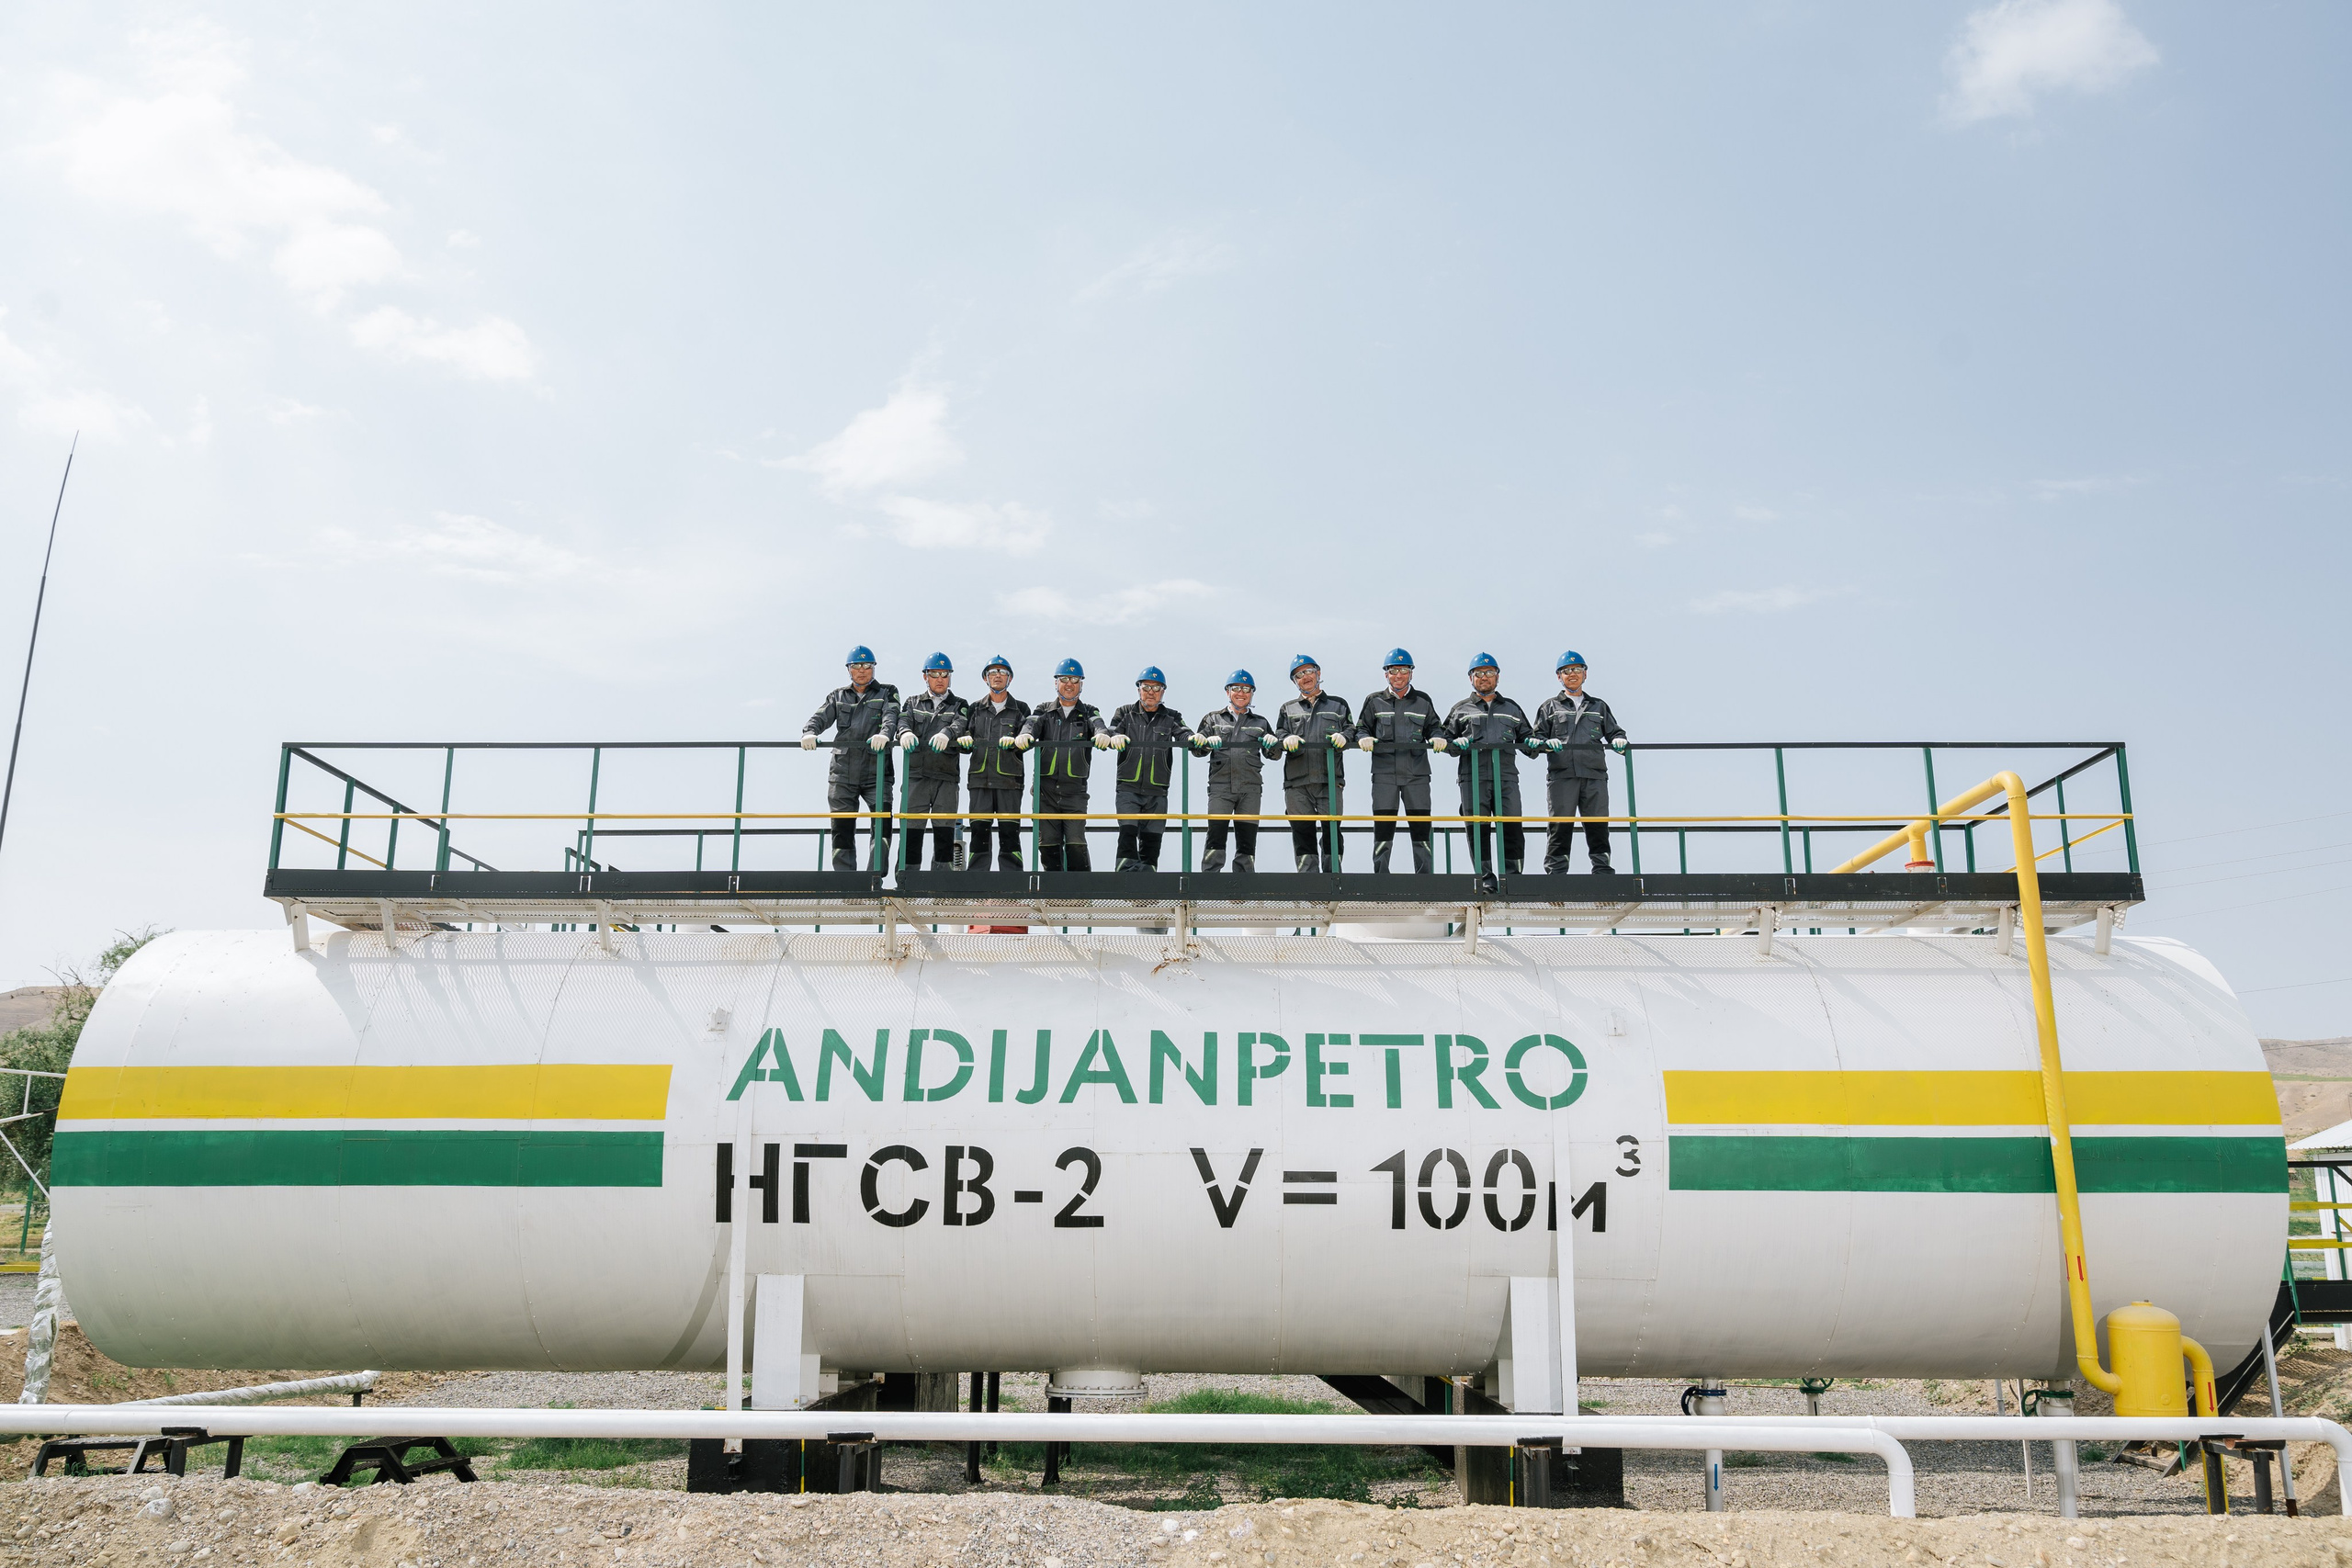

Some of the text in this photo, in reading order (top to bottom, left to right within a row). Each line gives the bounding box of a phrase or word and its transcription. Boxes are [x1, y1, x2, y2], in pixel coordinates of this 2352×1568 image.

[726, 1028, 1588, 1110] ANDIJANPETRO
[715, 1143, 1104, 1228] НГСВ-2
[1189, 1147, 1264, 1228] V
